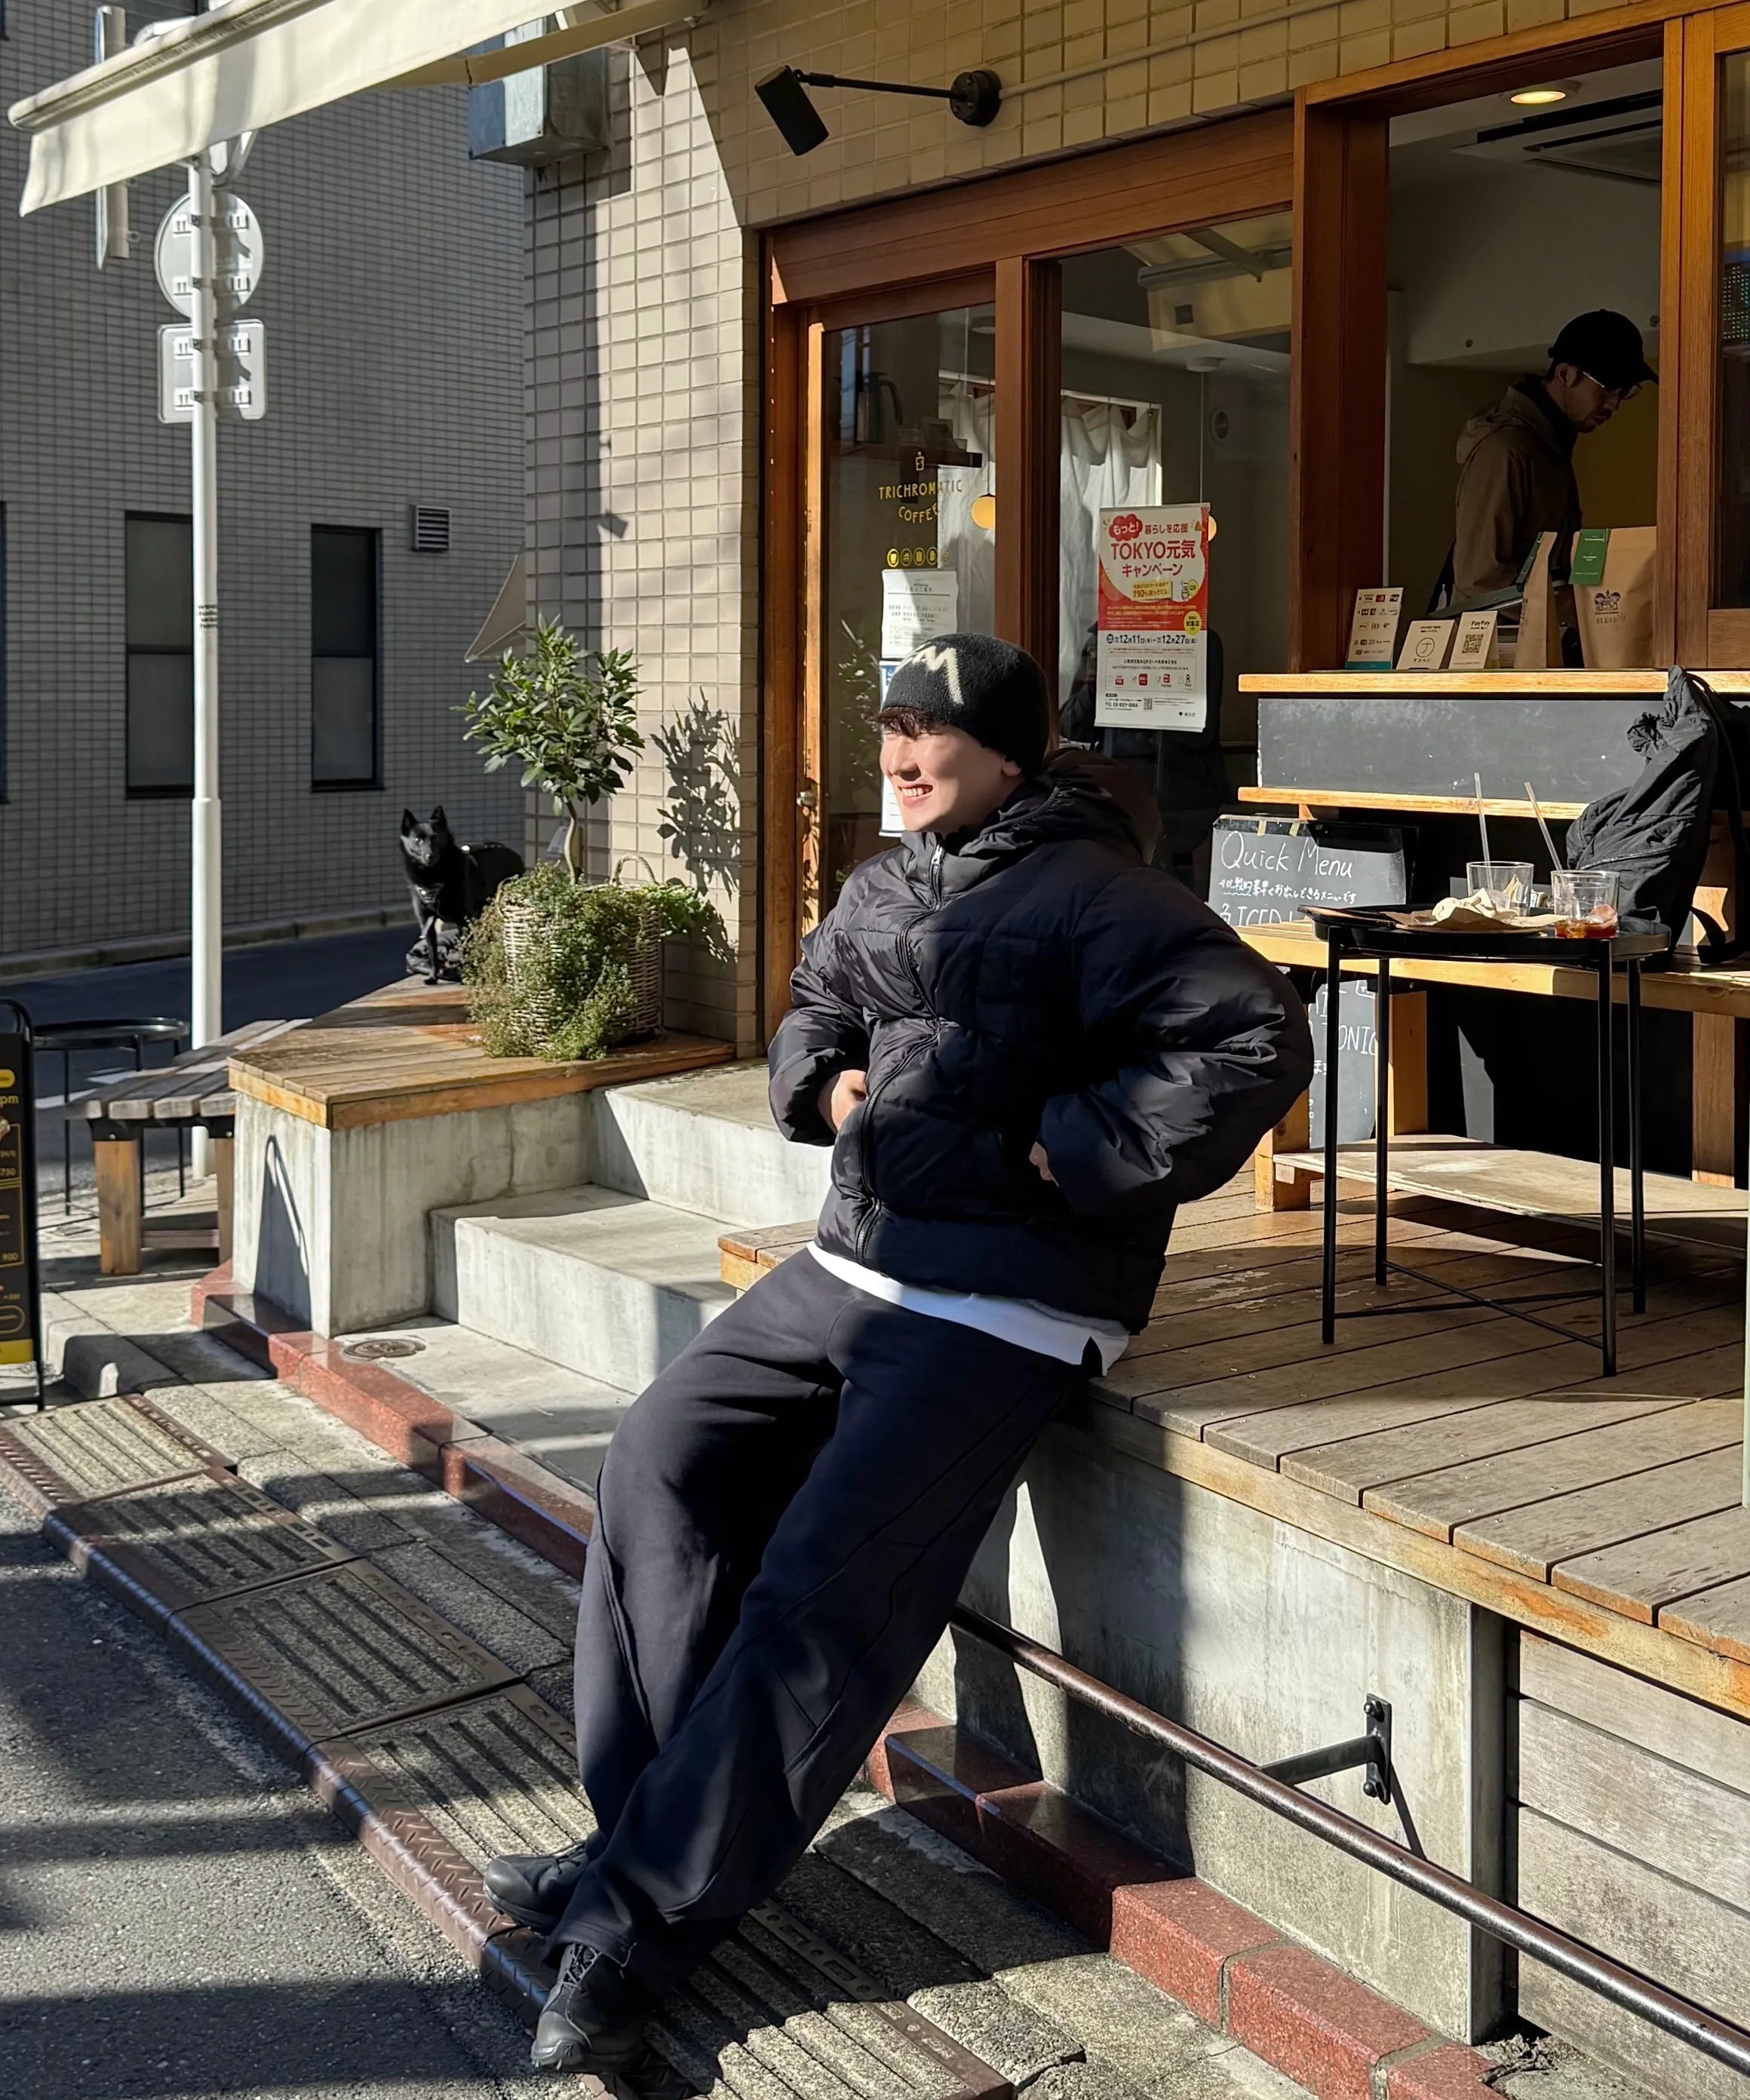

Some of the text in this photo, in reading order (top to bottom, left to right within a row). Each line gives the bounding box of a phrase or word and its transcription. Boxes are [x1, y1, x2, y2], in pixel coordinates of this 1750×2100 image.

[879, 479, 962, 500] TRICHROMATIC
[898, 502, 940, 523] COFFEE
[1110, 539, 1196, 560] TOKYO元気
[1122, 563, 1183, 578] キャンペーン
[1220, 830, 1353, 879] Quick Menu
